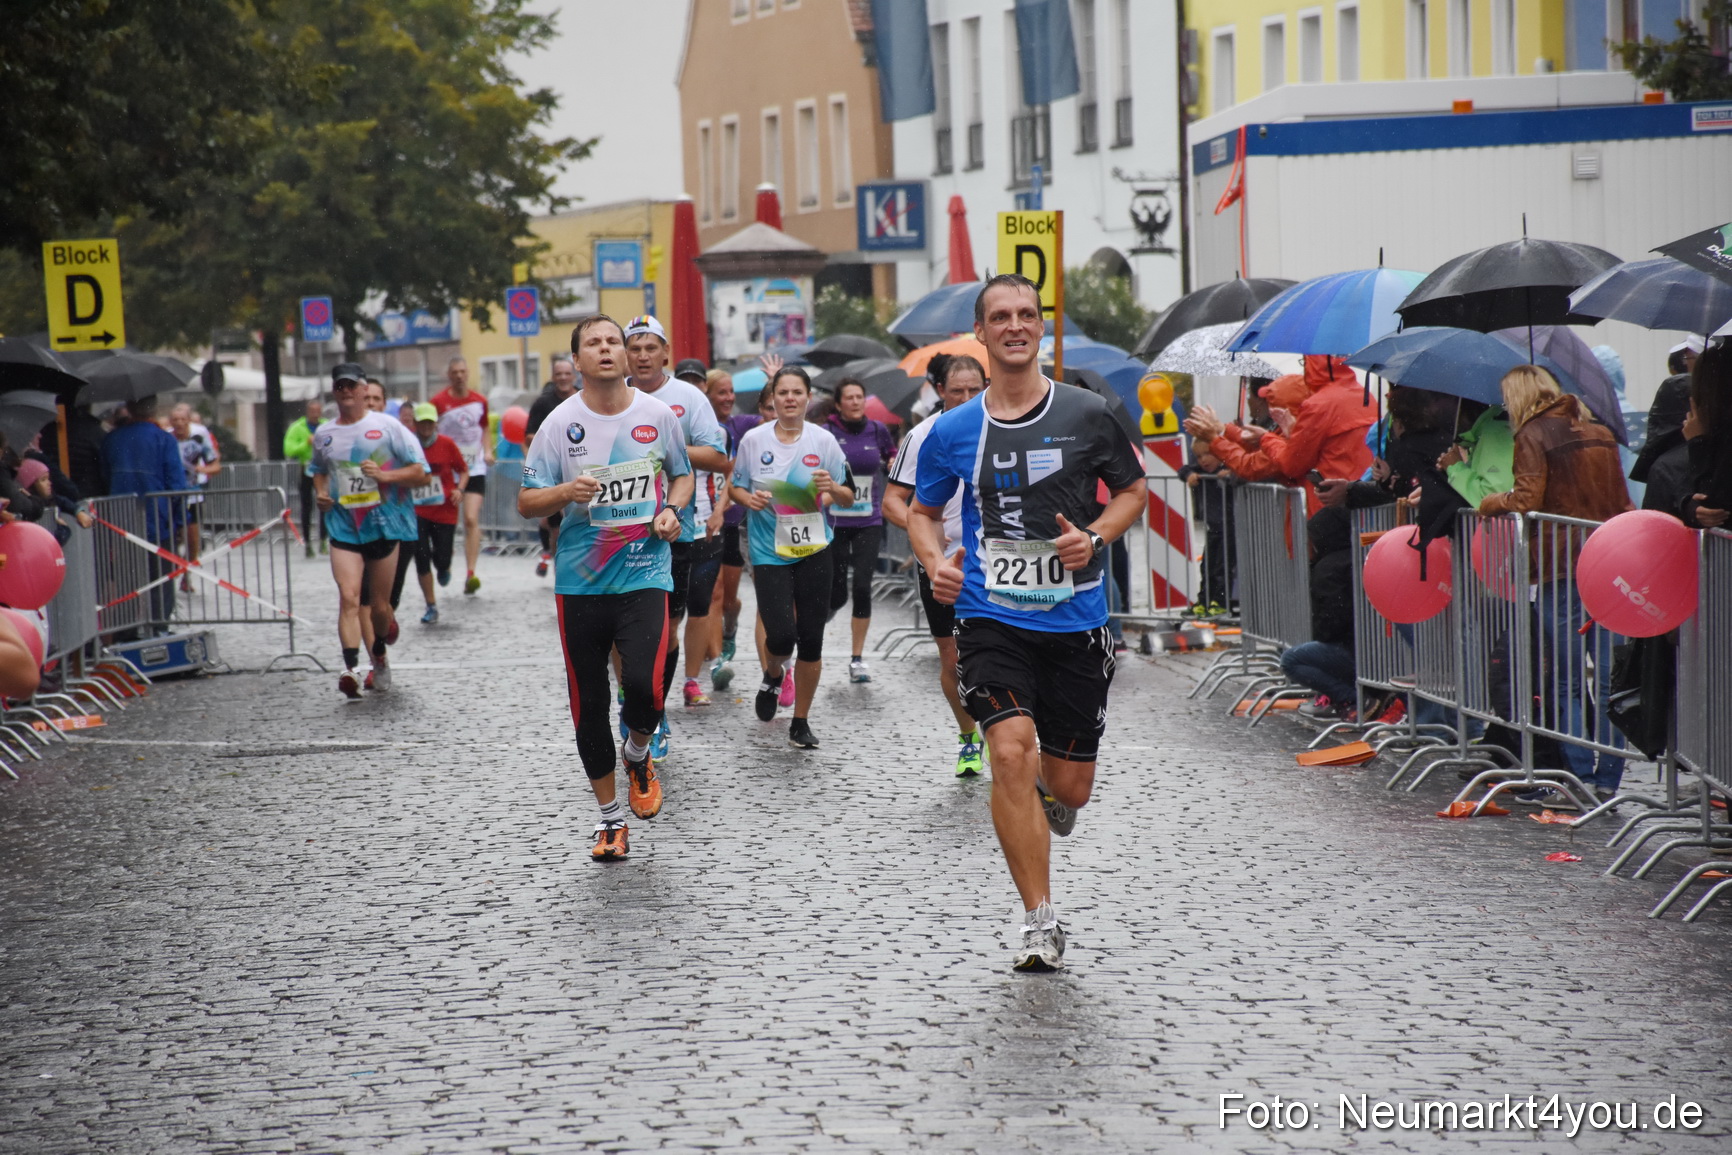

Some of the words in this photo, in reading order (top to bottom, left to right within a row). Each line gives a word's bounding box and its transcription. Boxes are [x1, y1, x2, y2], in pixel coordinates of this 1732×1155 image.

[1005, 215, 1056, 235] Block
[53, 245, 110, 266] Block
[1015, 244, 1047, 291] D
[66, 274, 104, 326] D
[348, 478, 365, 492] 72
[597, 475, 650, 504] 2077
[611, 507, 637, 518] David
[790, 526, 811, 544] 64
[1020, 541, 1057, 552] BOC
[993, 555, 1064, 585] 2210
